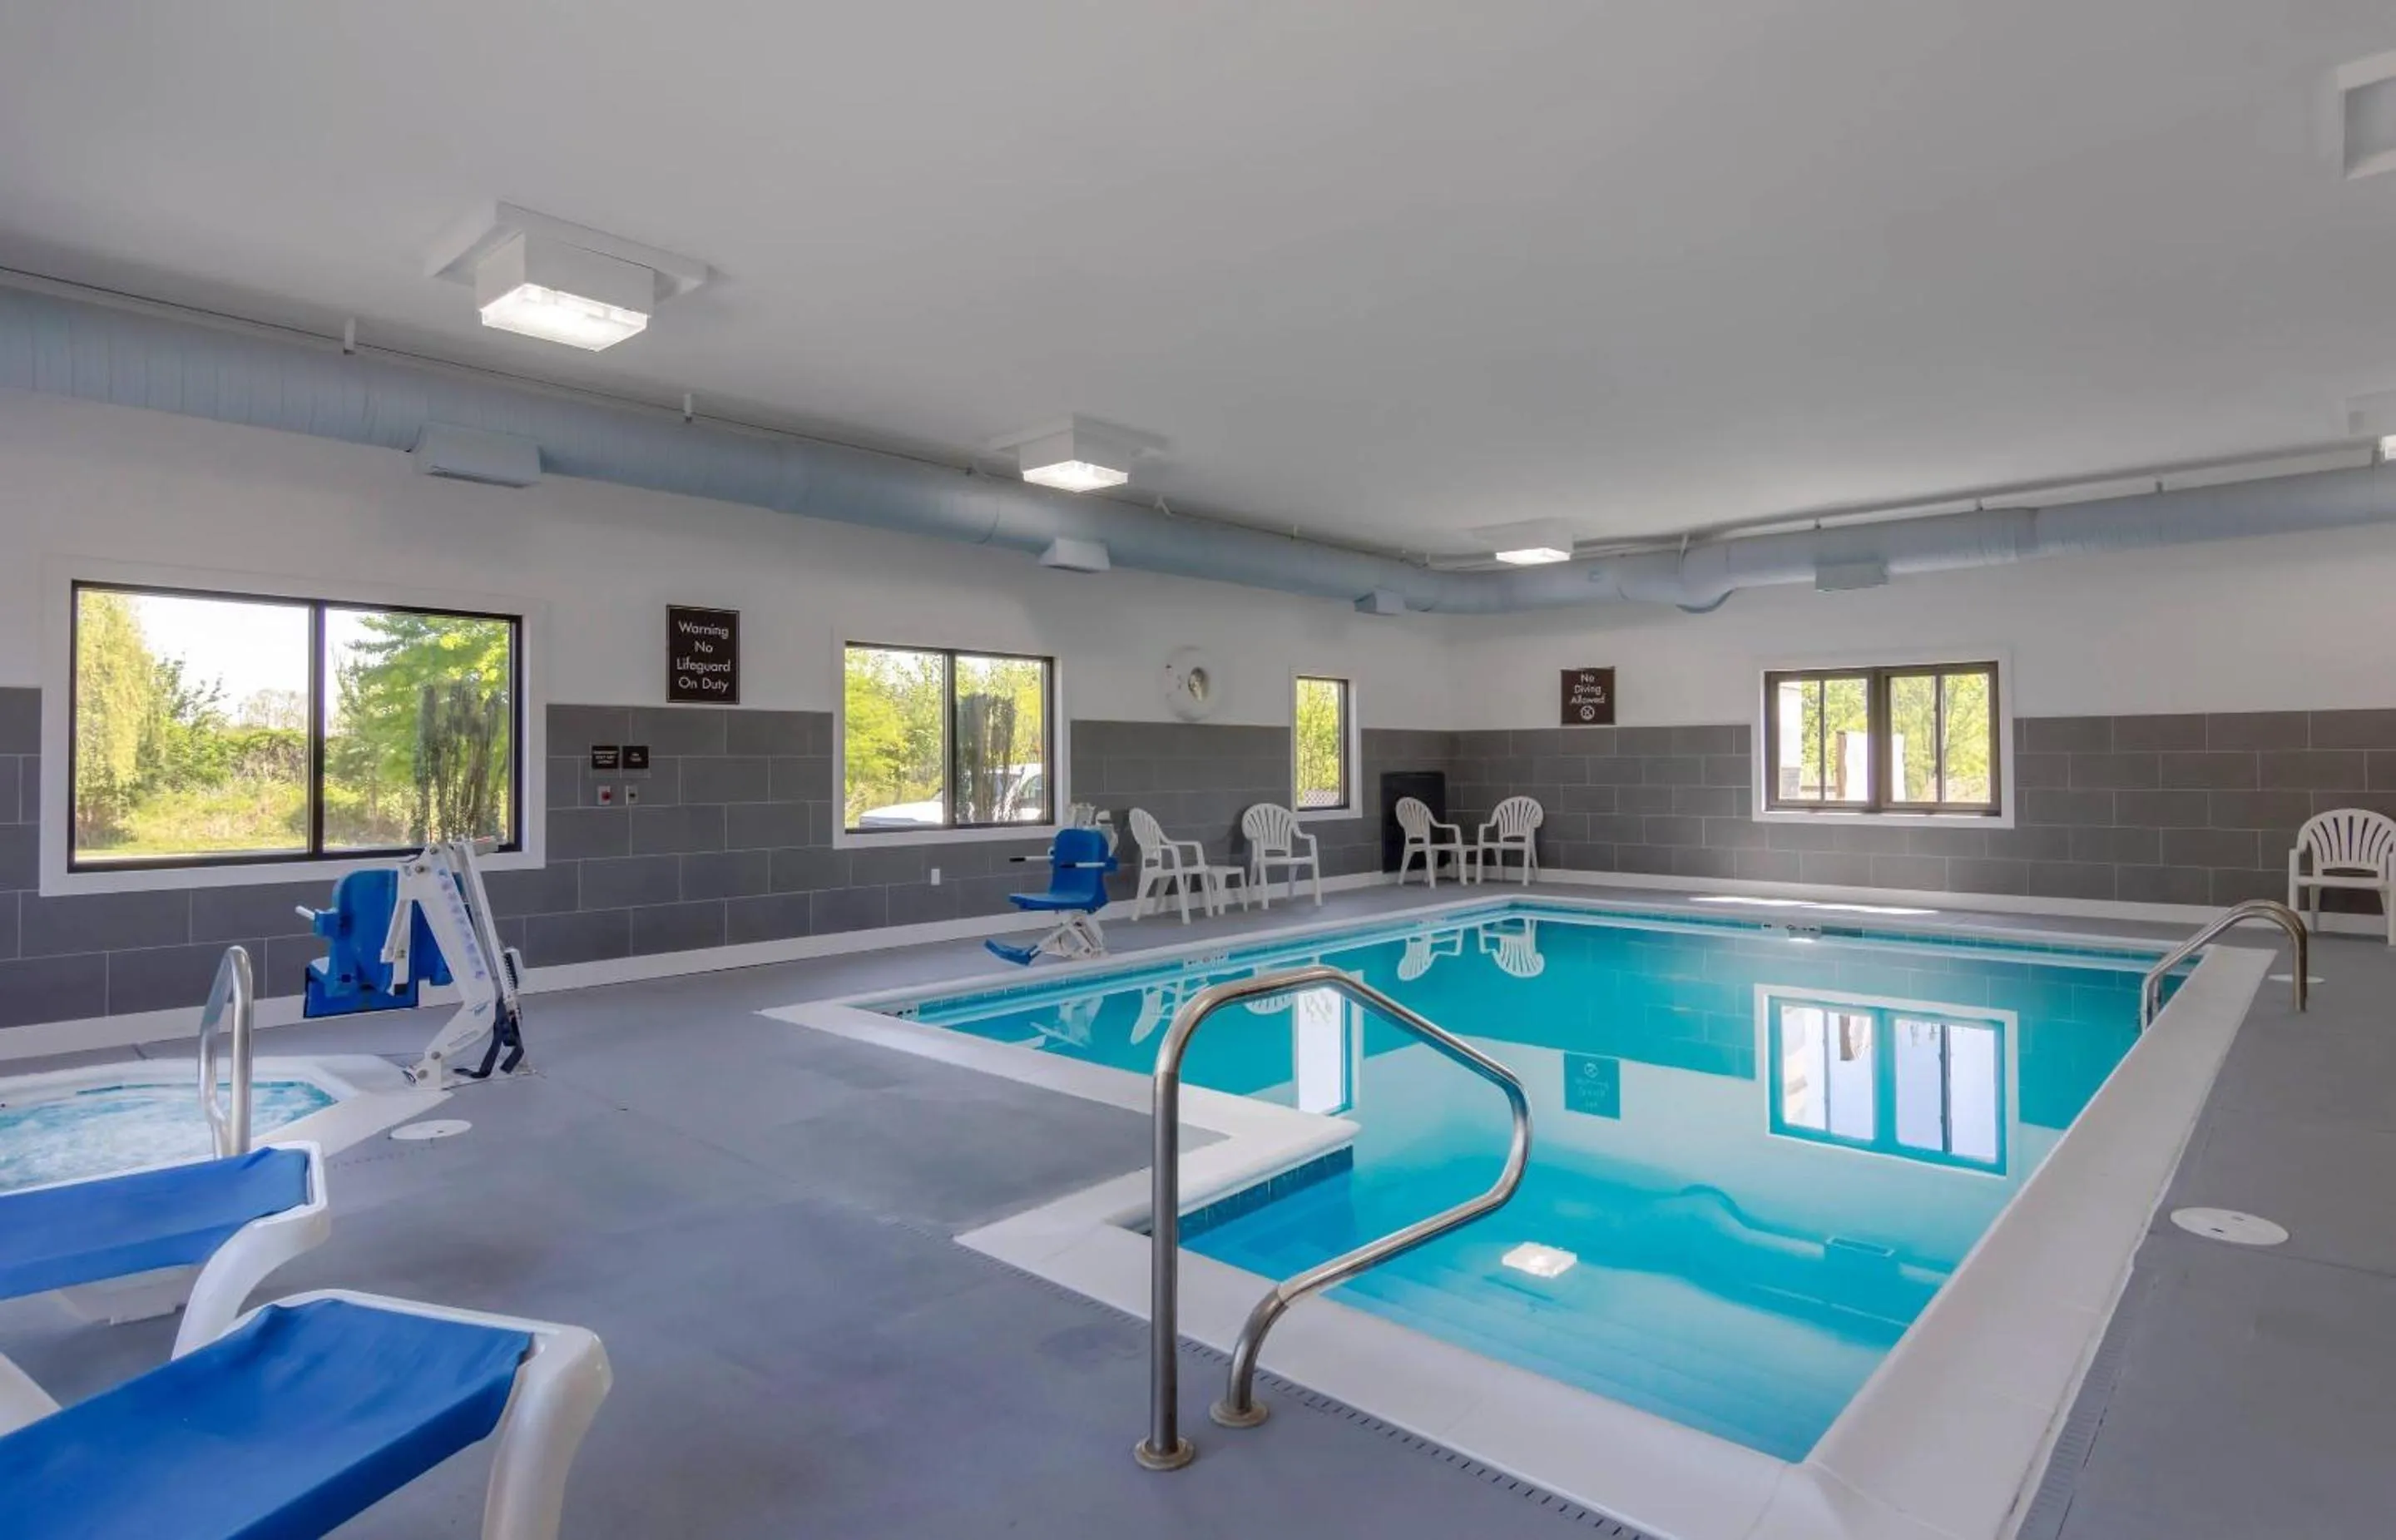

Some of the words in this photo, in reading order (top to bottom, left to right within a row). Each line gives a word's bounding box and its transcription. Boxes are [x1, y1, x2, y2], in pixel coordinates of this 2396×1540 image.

[678, 620, 729, 640] Warning
[694, 640, 713, 653] No
[676, 656, 730, 674] Lifeguard
[678, 676, 697, 689] On
[702, 677, 729, 693] Duty
[1581, 673, 1595, 682] No
[1574, 684, 1601, 696] Diving
